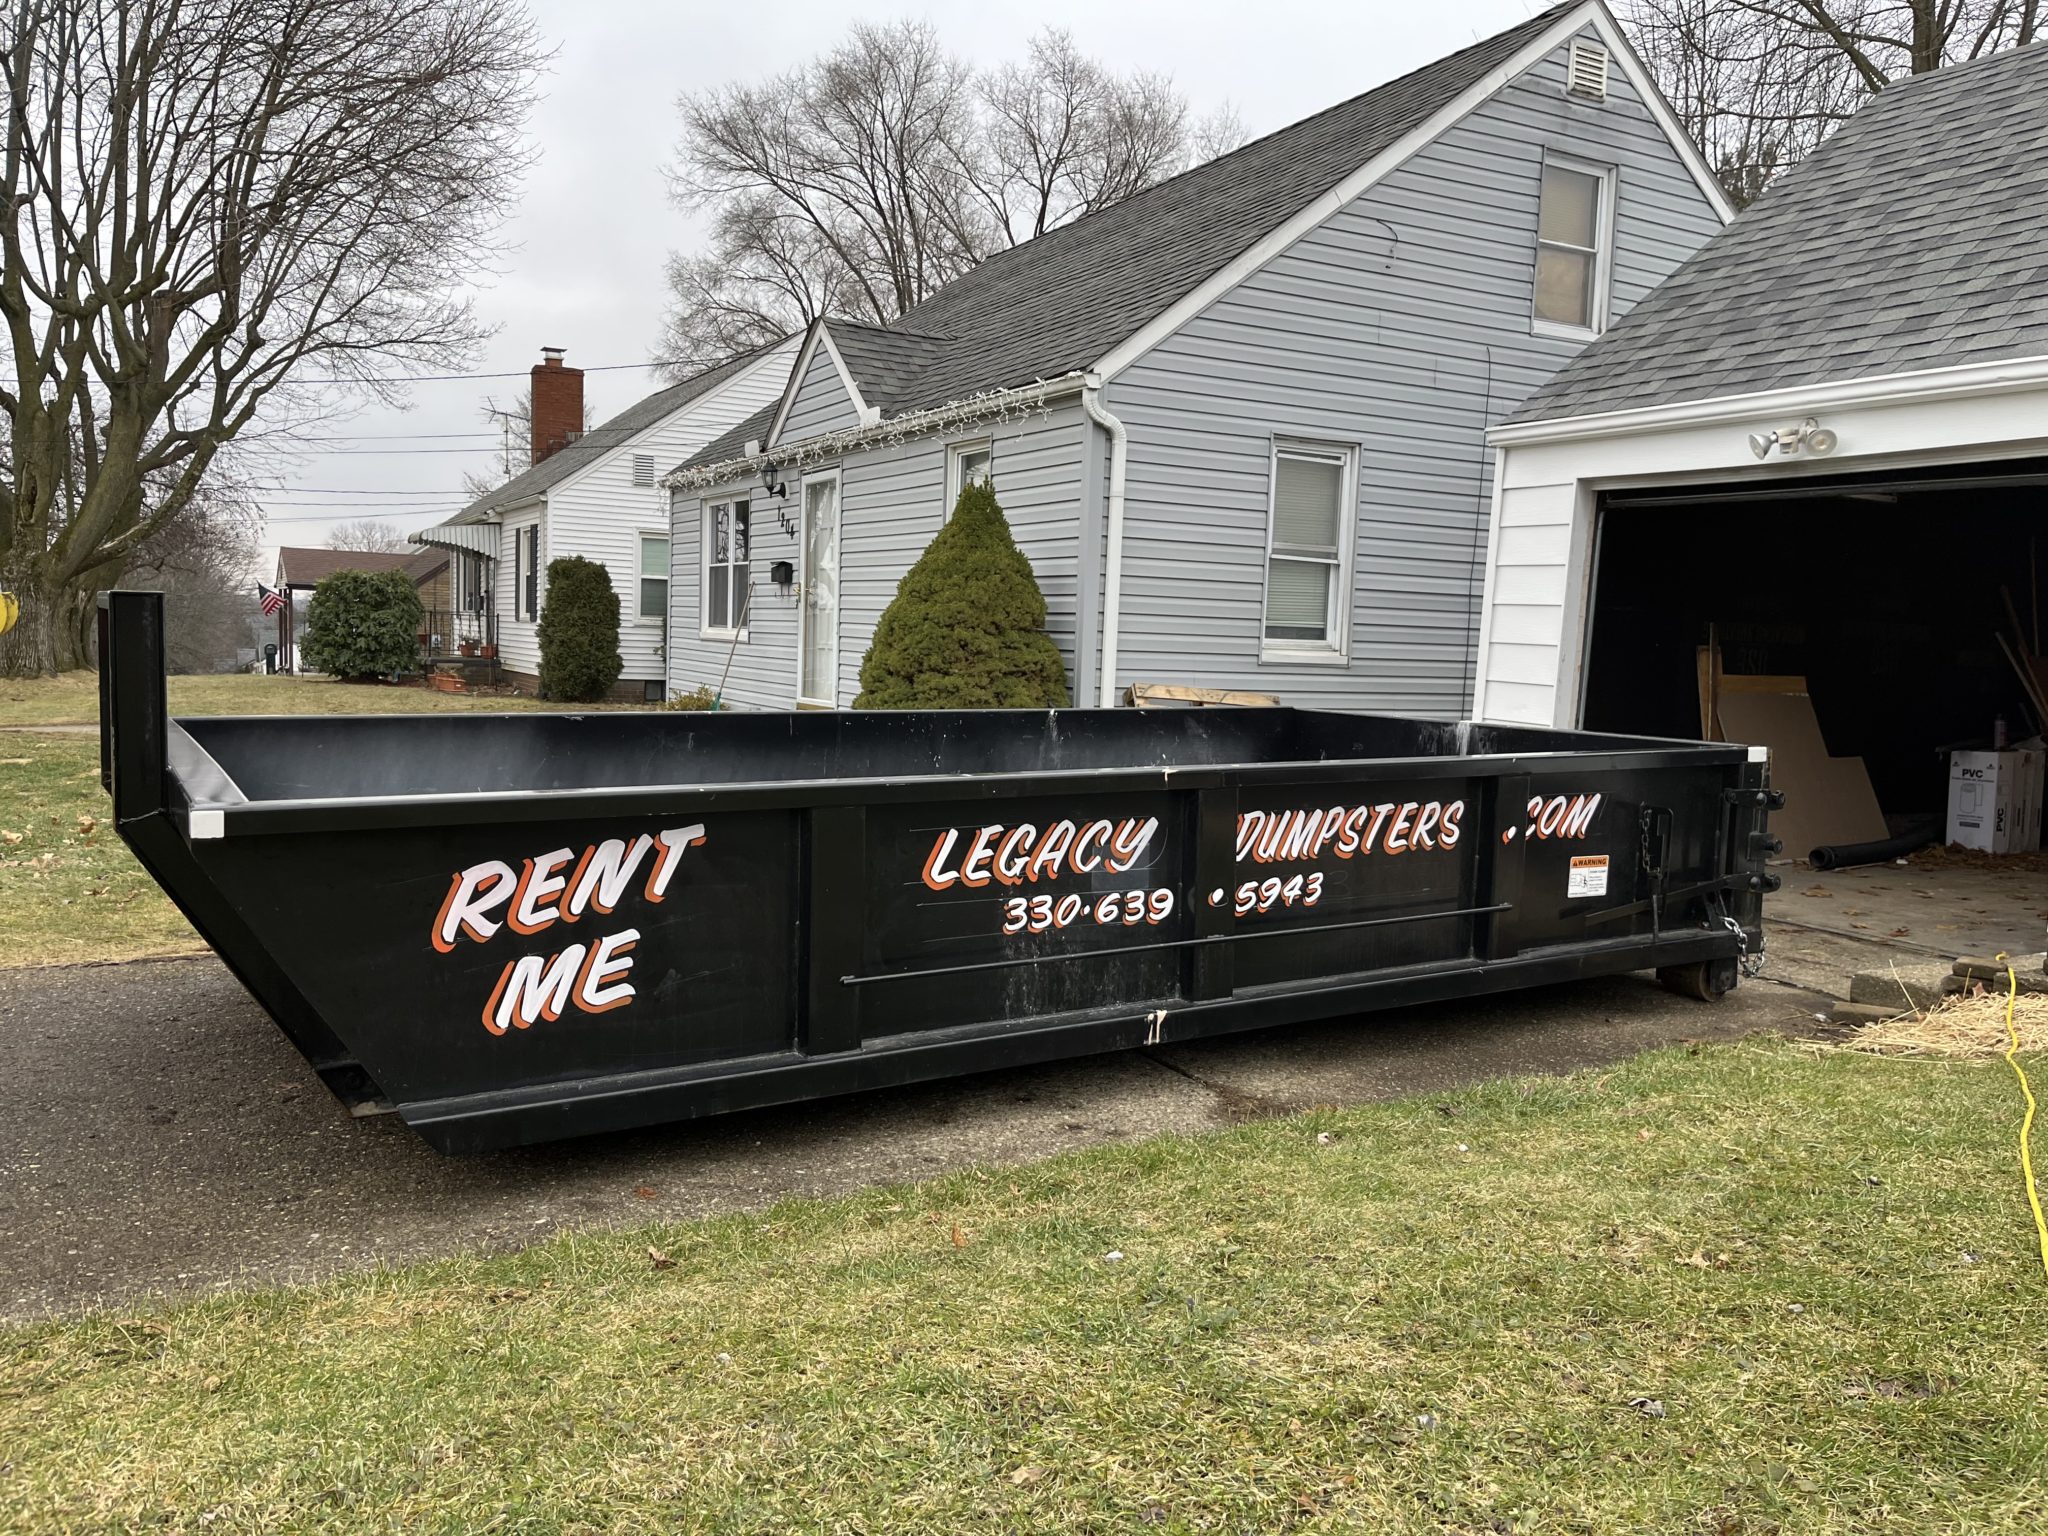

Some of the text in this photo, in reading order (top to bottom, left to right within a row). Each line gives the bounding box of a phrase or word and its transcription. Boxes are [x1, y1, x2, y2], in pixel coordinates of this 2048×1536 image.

[1962, 768, 1984, 778] PVC
[922, 816, 1159, 891] LEGACY
[1236, 799, 1466, 864] DUMPSTERS
[1996, 807, 2004, 832] PVC
[431, 823, 707, 953] RENT
[1578, 858, 1607, 867] WARNING
[482, 928, 641, 1036] ME
